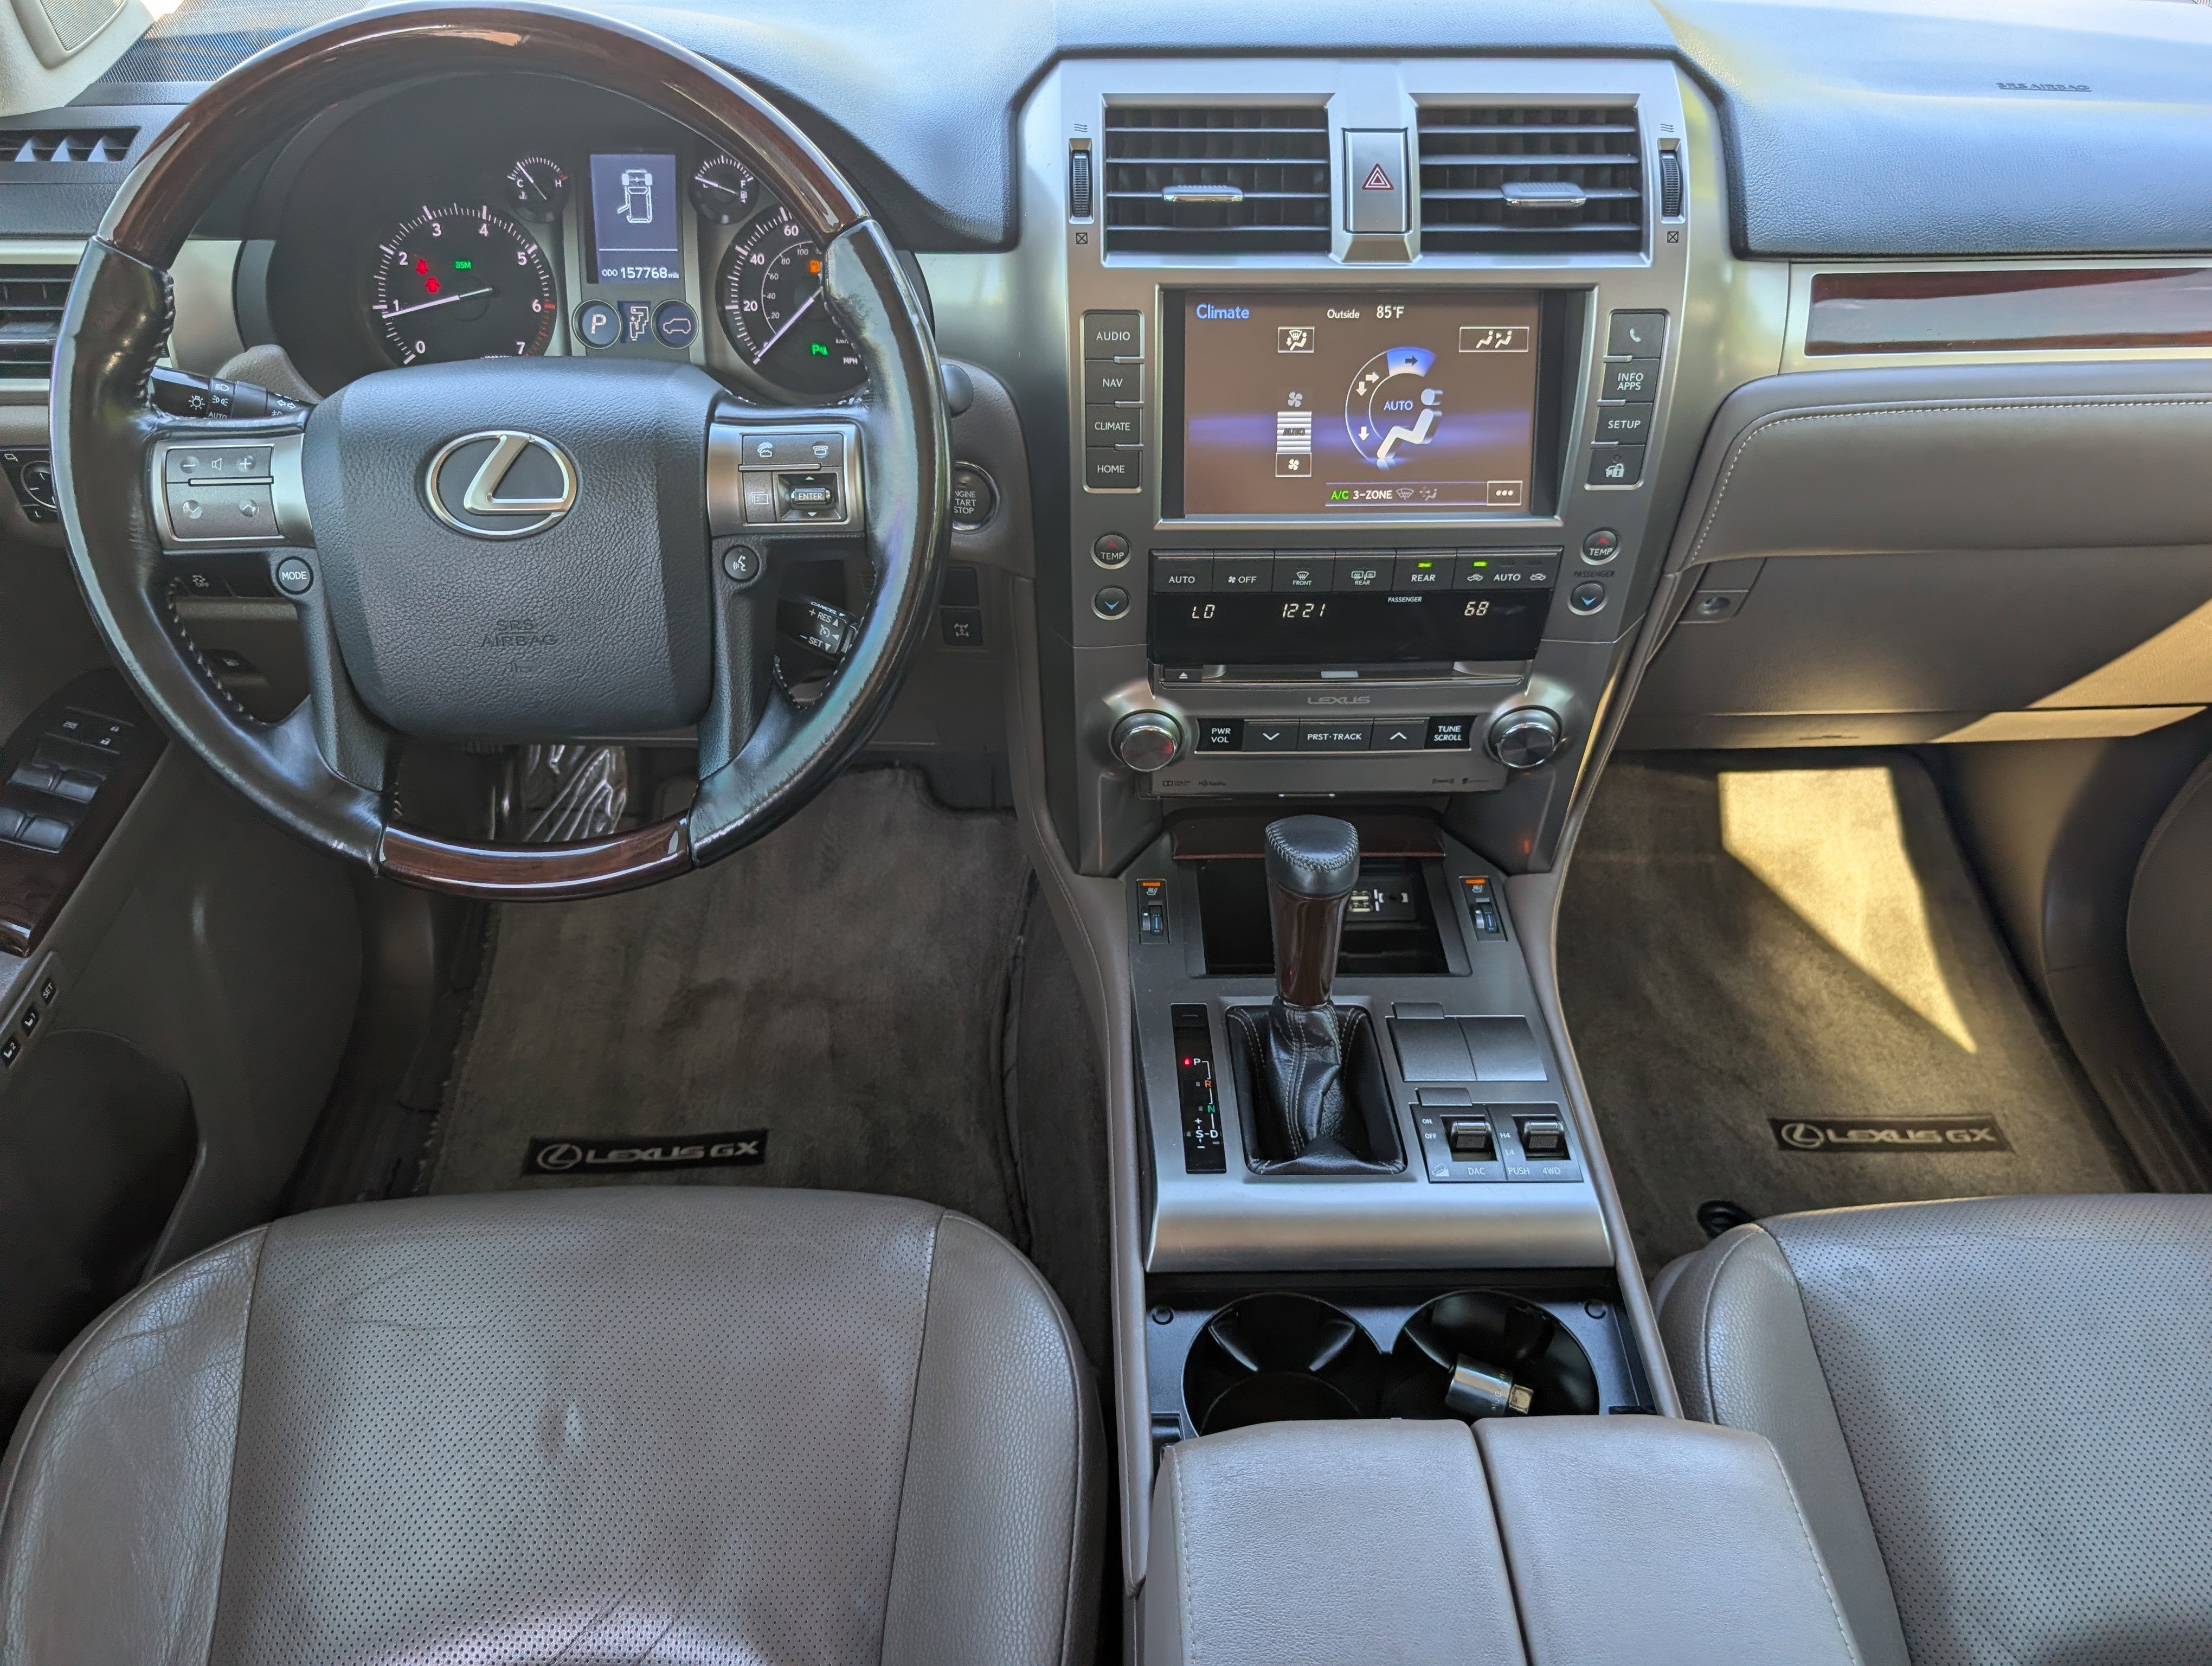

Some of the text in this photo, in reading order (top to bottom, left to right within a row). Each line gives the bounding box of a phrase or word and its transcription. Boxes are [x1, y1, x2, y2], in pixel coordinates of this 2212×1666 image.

[517, 179, 523, 188] C
[555, 180, 562, 188] H
[741, 180, 746, 189] F
[433, 223, 441, 236] 3
[478, 225, 488, 236] 4
[783, 225, 799, 236] 60
[398, 252, 408, 265] 2
[517, 252, 527, 265] 5
[750, 253, 765, 265] 40
[620, 267, 667, 279] 157768
[393, 299, 399, 311] 1
[532, 299, 542, 312] 6
[743, 300, 758, 312] 20
[1196, 303, 1250, 319] Climate
[1327, 304, 1405, 319] Outside 85°F
[1096, 331, 1130, 341] AUDIO
[415, 341, 426, 354] 0
[516, 341, 525, 355] 7
[843, 356, 858, 364] MPH
[1617, 372, 1643, 382] INFO
[1102, 379, 1123, 387] NAV
[1617, 382, 1641, 390] APPS
[1383, 400, 1413, 411] AUTO
[208, 411, 228, 419] AUTO
[1094, 422, 1130, 431] CLIMATE
[1607, 420, 1641, 429] SETUP
[1097, 465, 1125, 473] HOME
[1330, 489, 1393, 500] A/C 3-ZONE
[955, 498, 976, 507] TART
[954, 506, 974, 514] STOP
[1100, 552, 1124, 560] TEMP
[1589, 548, 1613, 556] TEMP
[281, 571, 307, 581] MODE
[1168, 576, 1195, 584] AUTO
[1411, 573, 1436, 582] REAR
[1493, 573, 1521, 581] AUTO
[810, 601, 837, 615] CANCEL
[1464, 601, 1489, 616] 68
[817, 612, 832, 623] RES
[497, 618, 535, 631] SRS
[481, 634, 558, 648] AIRBAG
[808, 637, 824, 648] SET
[1307, 696, 1371, 704] LEXUS
[43, 982, 53, 998] SET
[1205, 1080, 1212, 1088] R
[1207, 1105, 1216, 1113] N
[1195, 1130, 1204, 1138] S
[1210, 1130, 1218, 1138] D
[1826, 1129, 1943, 1144] LEXUS
[1945, 1127, 1998, 1143] GX
[585, 1145, 705, 1164] LEXUS
[710, 1140, 758, 1158] GX
[1468, 1167, 1486, 1175] DAC
[1508, 1167, 1560, 1175] PUSH 4WD
